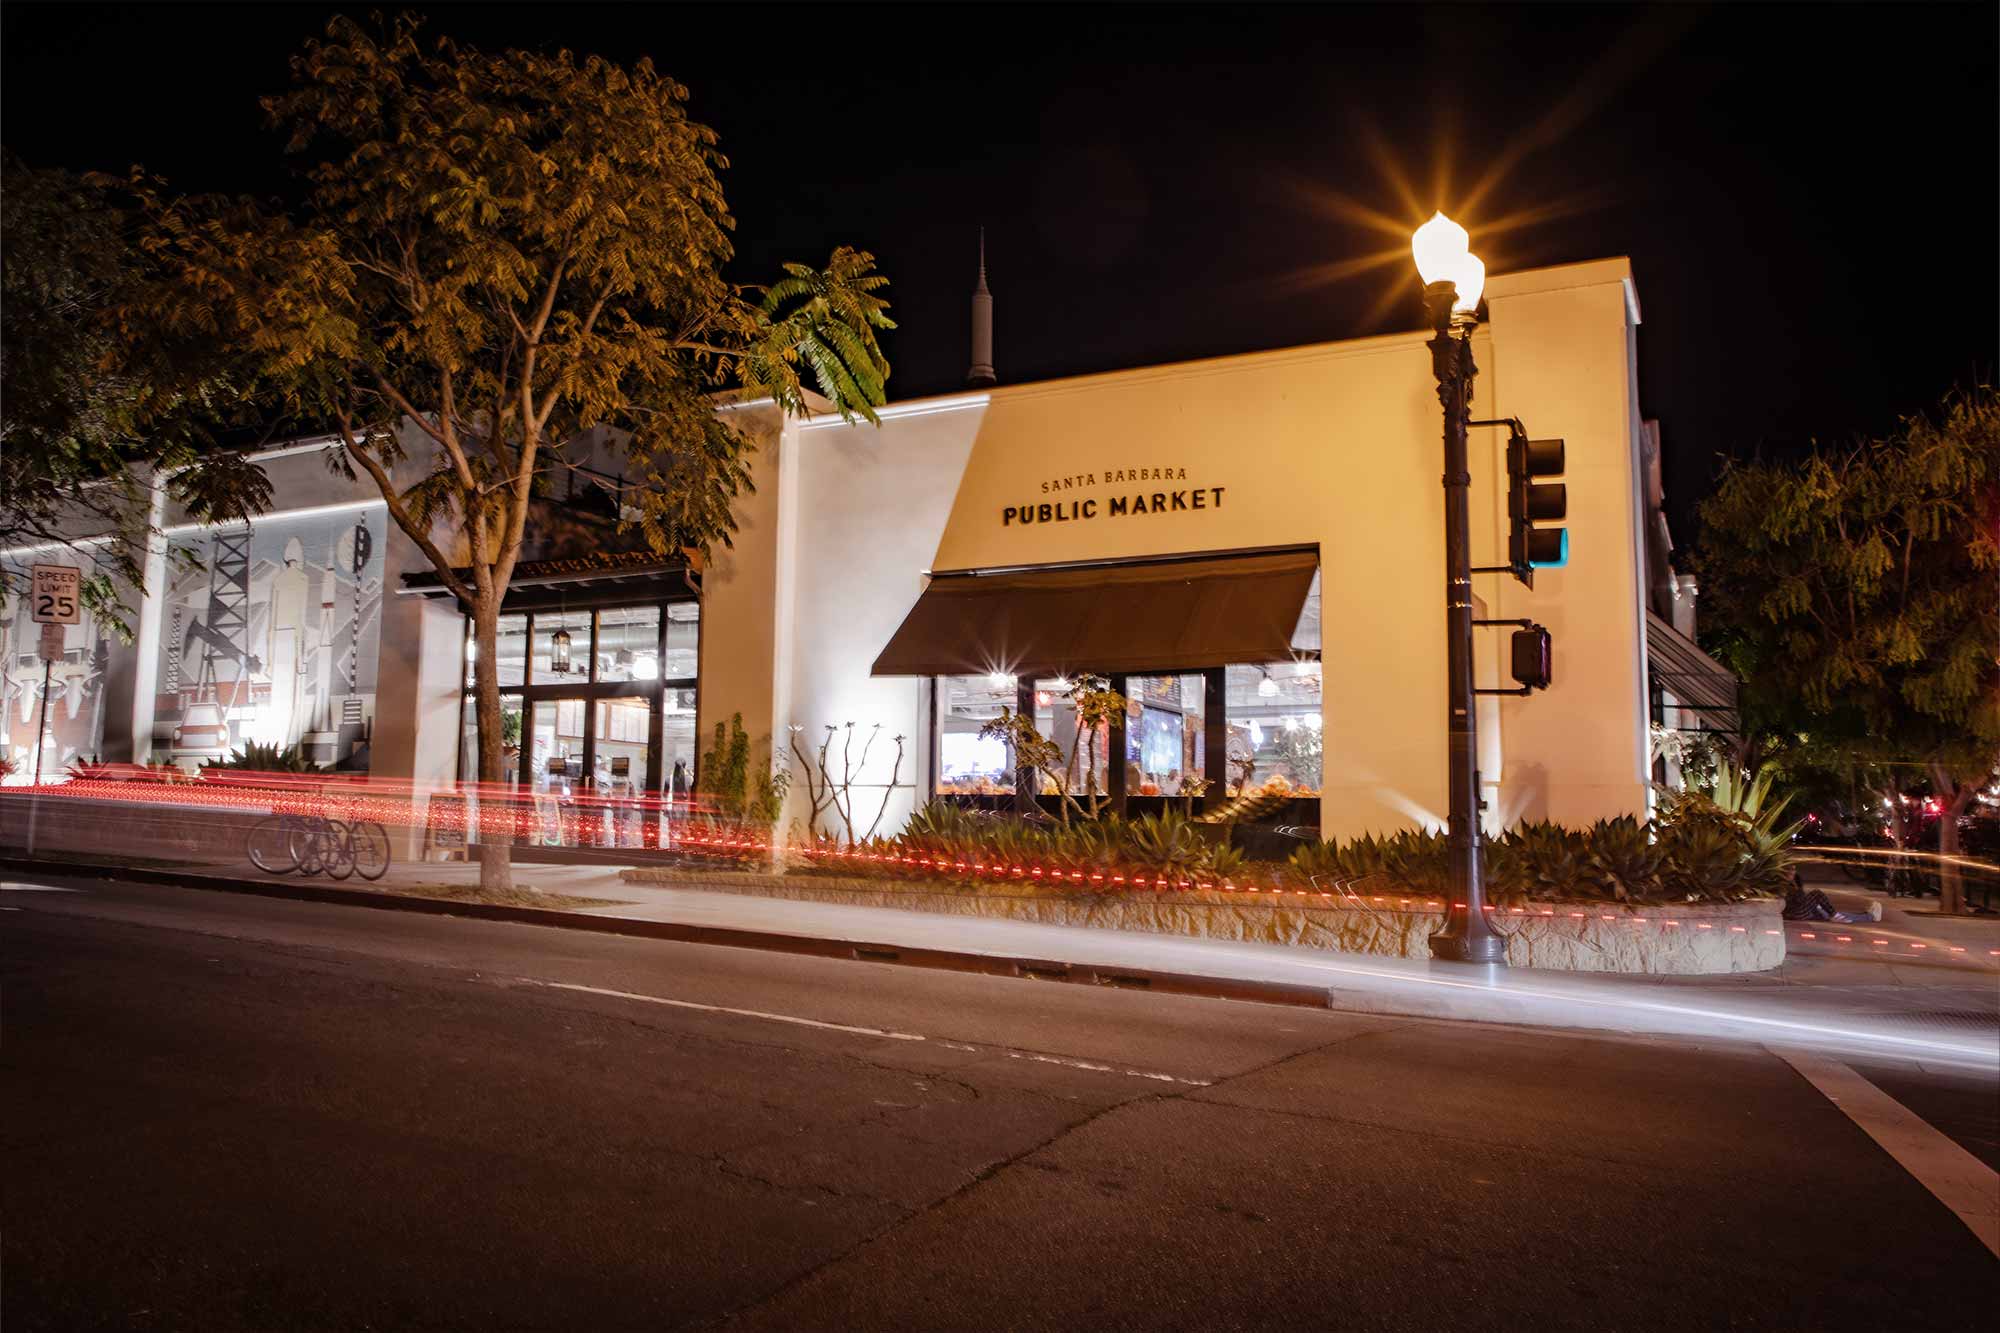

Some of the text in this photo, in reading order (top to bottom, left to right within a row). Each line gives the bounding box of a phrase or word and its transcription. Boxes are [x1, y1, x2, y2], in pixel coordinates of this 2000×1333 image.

[1041, 467, 1187, 494] SANTA BARBARA
[1003, 487, 1225, 526] PUBLIC MARKET
[37, 571, 76, 582] SPEED
[41, 584, 72, 594] LIMIT
[38, 595, 74, 617] 25
